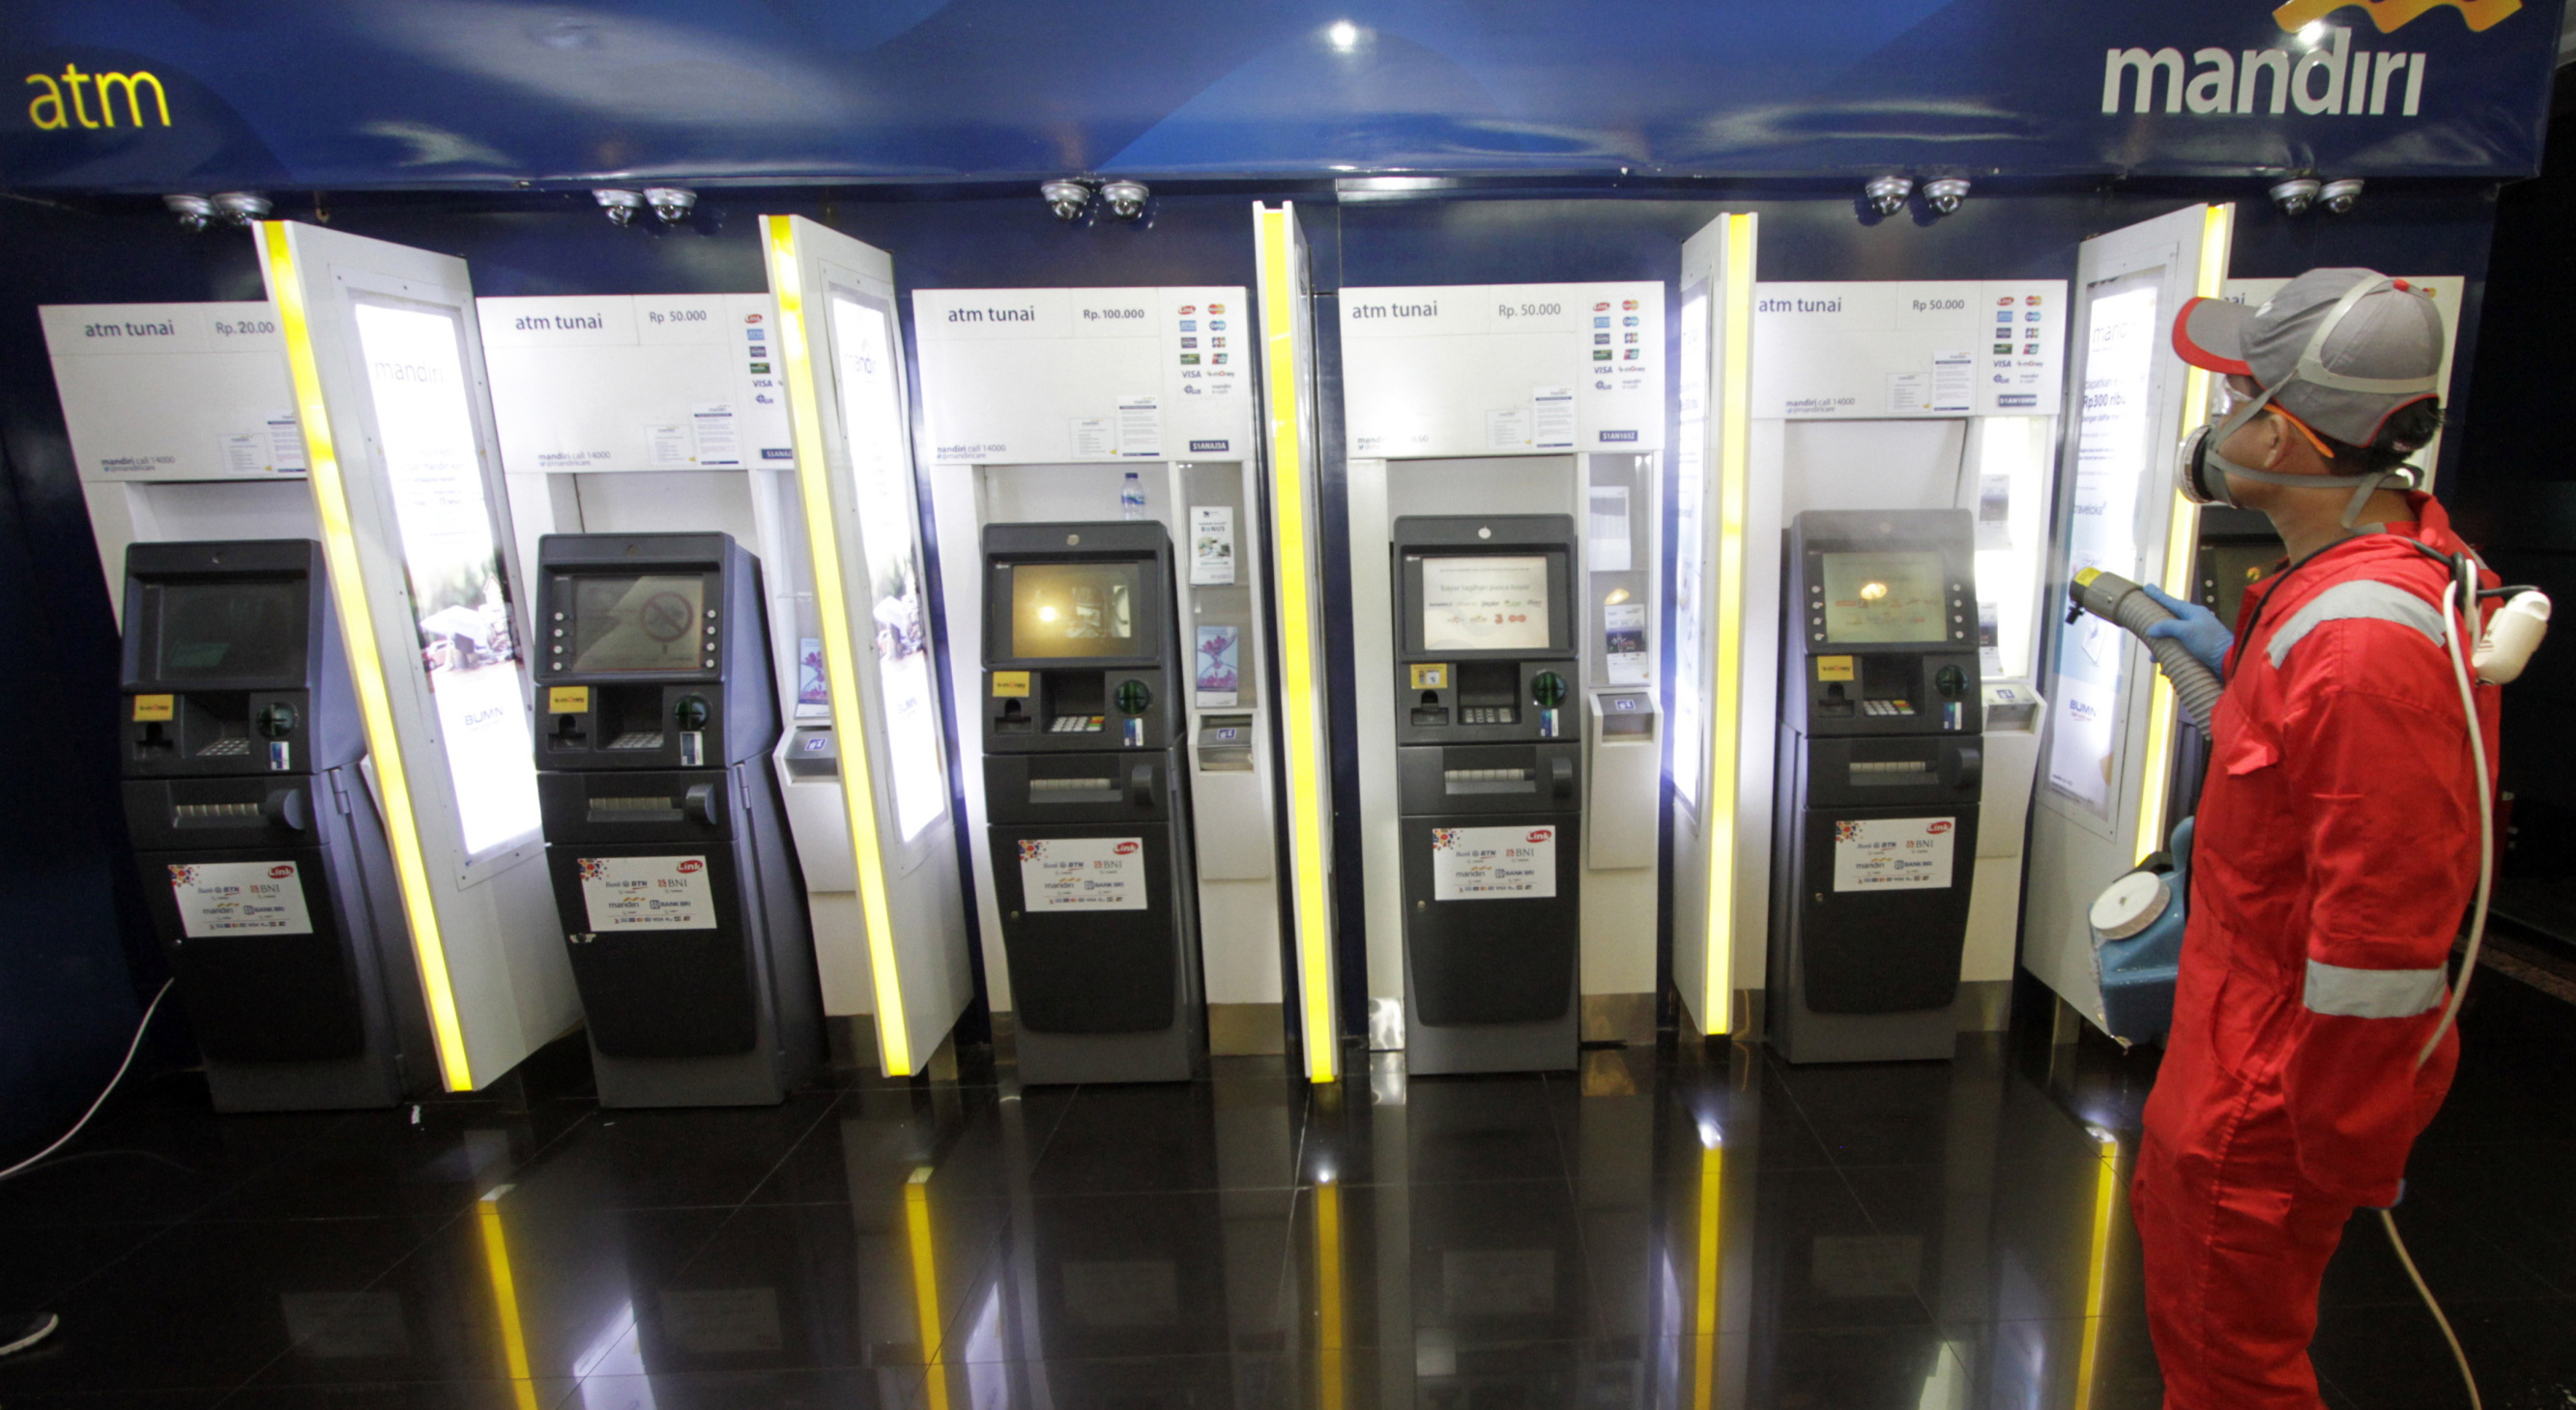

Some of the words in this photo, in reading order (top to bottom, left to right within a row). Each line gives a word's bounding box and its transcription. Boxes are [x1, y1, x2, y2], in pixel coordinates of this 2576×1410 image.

[2101, 26, 2426, 116] mandiri
[26, 63, 172, 129] atm
[1352, 303, 1387, 319] atm
[1392, 300, 1437, 317] tunai
[1498, 304, 1518, 319] Rp.
[1521, 302, 1561, 316] 50.000
[1758, 298, 1792, 312] atm
[1797, 297, 1841, 313] tunai
[1913, 301, 1926, 311] Rp
[1928, 300, 1965, 310] 50.000
[649, 311, 665, 325] Rp
[670, 310, 708, 322] 50.000
[948, 308, 983, 323] atm
[988, 305, 1035, 322] tunai
[1084, 309, 1101, 321] Rp.
[1103, 308, 1145, 319] 100.000
[515, 315, 551, 331] atm
[556, 312, 603, 330] tunai
[85, 322, 121, 337] atm
[125, 319, 175, 336] tunai
[216, 322, 237, 337] Rp.
[1833, 397, 1855, 406] 14000
[968, 444, 981, 452] call
[982, 444, 1006, 452] 14000
[101, 456, 134, 466] mandiri
[135, 456, 150, 465] call
[151, 455, 176, 464] 14000
[538, 452, 570, 461] mandiri
[571, 451, 586, 460] call
[587, 450, 611, 460] 14000
[1928, 822, 1950, 832] Link
[1527, 831, 1548, 841] Link
[1114, 845, 1137, 853] Link
[1916, 840, 1934, 849] BNI
[1516, 849, 1535, 857] BNI
[678, 861, 702, 872] Link
[1104, 860, 1123, 869] BNI
[668, 878, 688, 887] BNI
[260, 884, 280, 893] BNI
